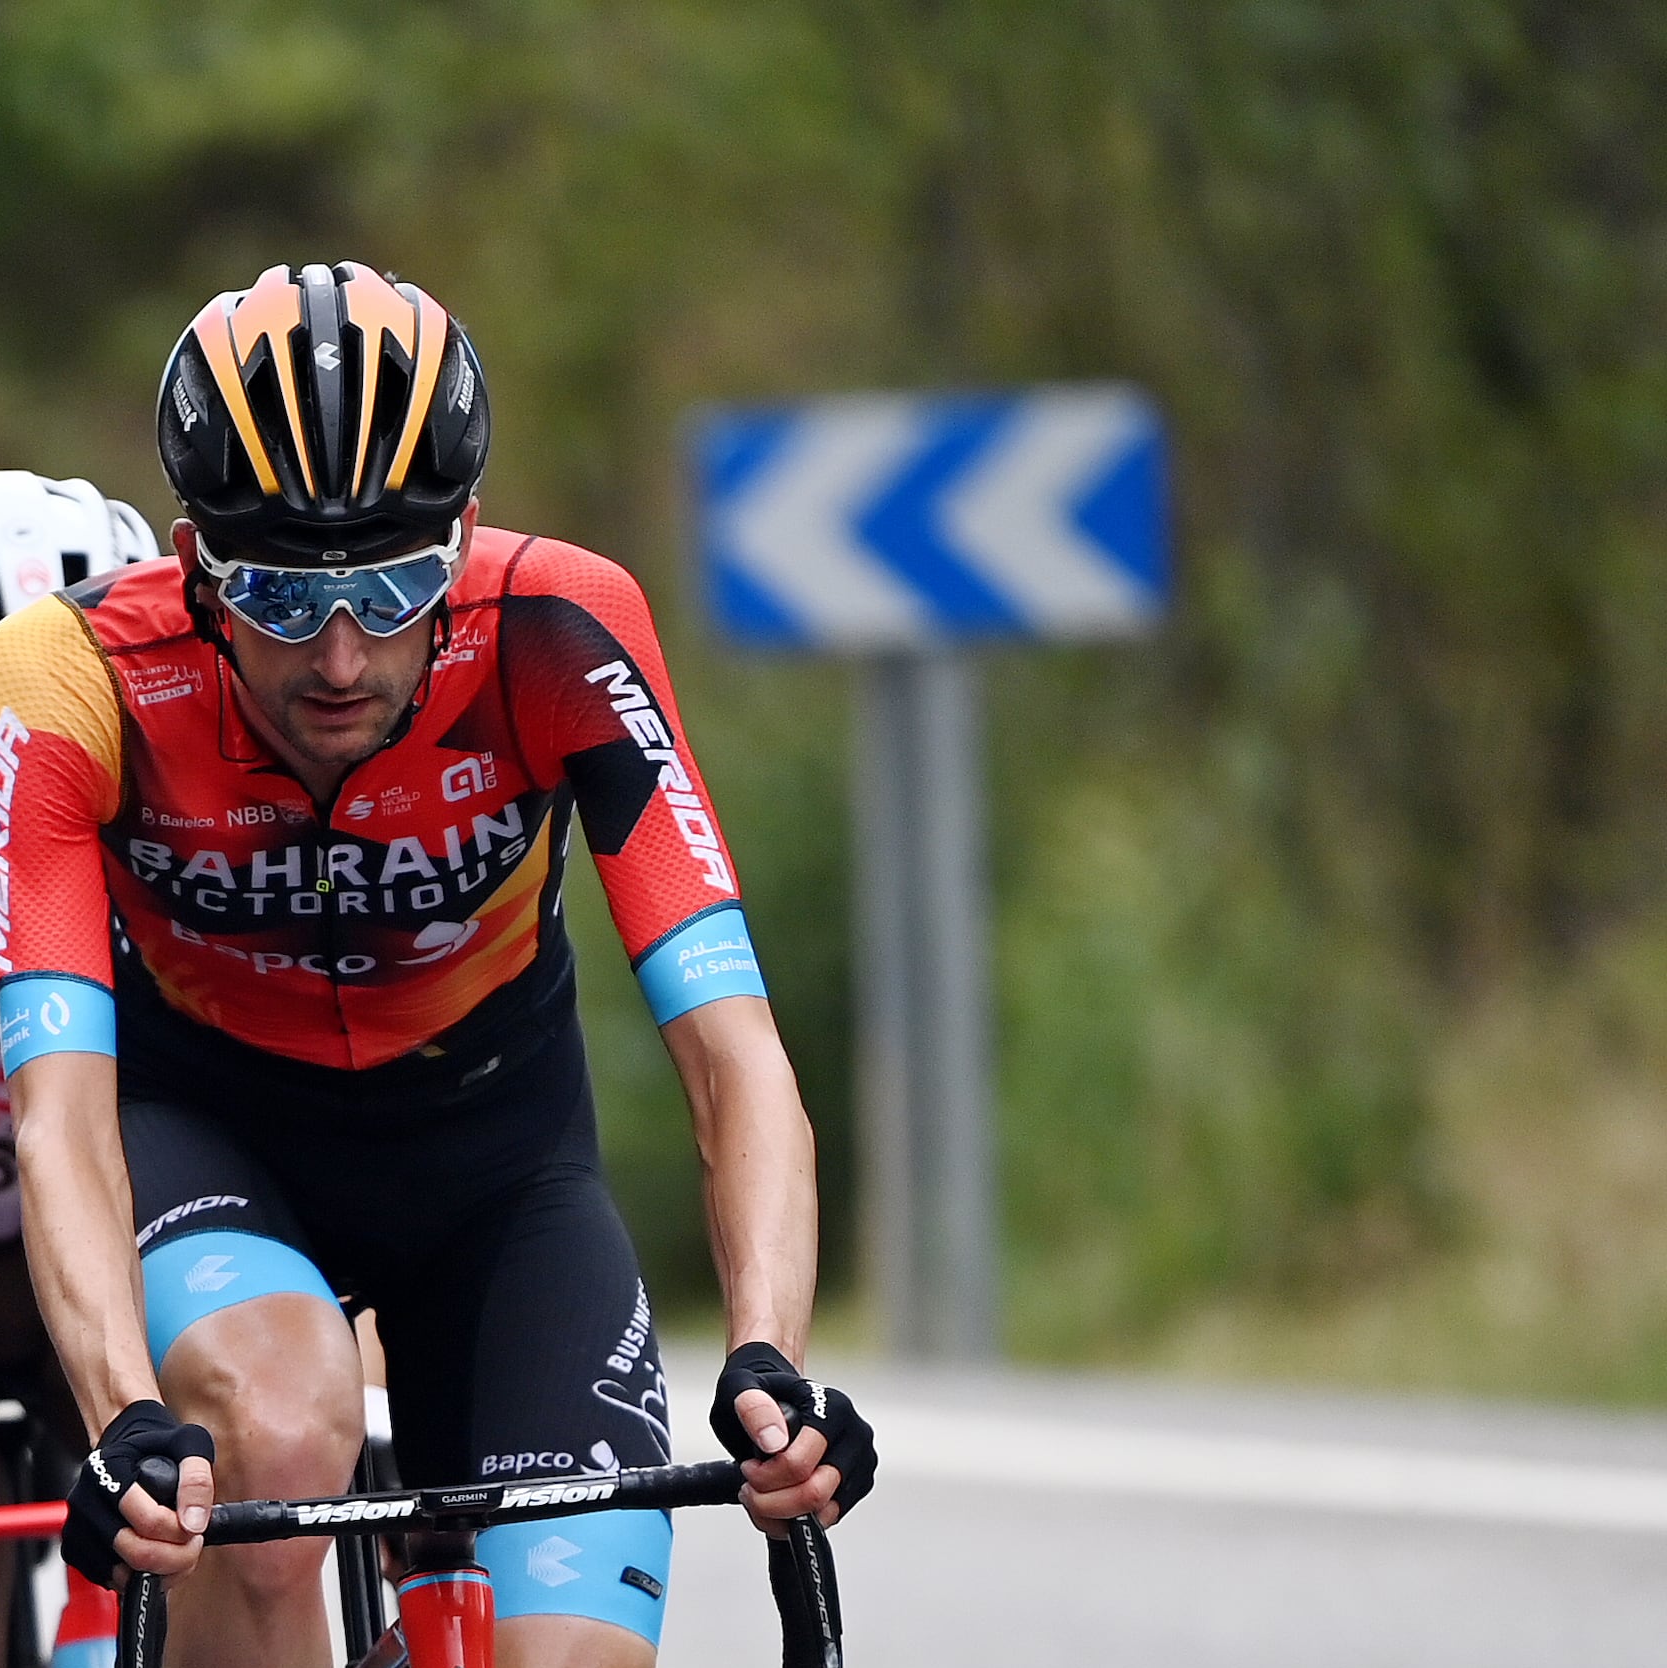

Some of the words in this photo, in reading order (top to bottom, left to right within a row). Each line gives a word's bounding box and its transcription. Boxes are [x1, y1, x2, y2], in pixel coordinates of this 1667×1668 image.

[584, 659, 736, 894] MERIDA
[380, 785, 404, 799] UCI
[380, 791, 422, 808] WORLD
[160, 813, 216, 829] Batelco
[226, 804, 277, 828] NBB
[381, 803, 412, 817] TEAM
[128, 801, 525, 889] BAHRAIN
[130, 840, 529, 916] VICTORIOUS
[169, 919, 378, 976] Bapco
[683, 963, 703, 984] Al
[135, 1194, 250, 1250] ERIDA
[605, 1276, 652, 1374] BUSINES
[480, 1449, 575, 1477] Bapco
[440, 1491, 488, 1504] GARMIN
[802, 1527, 832, 1640] DURA-ACE
